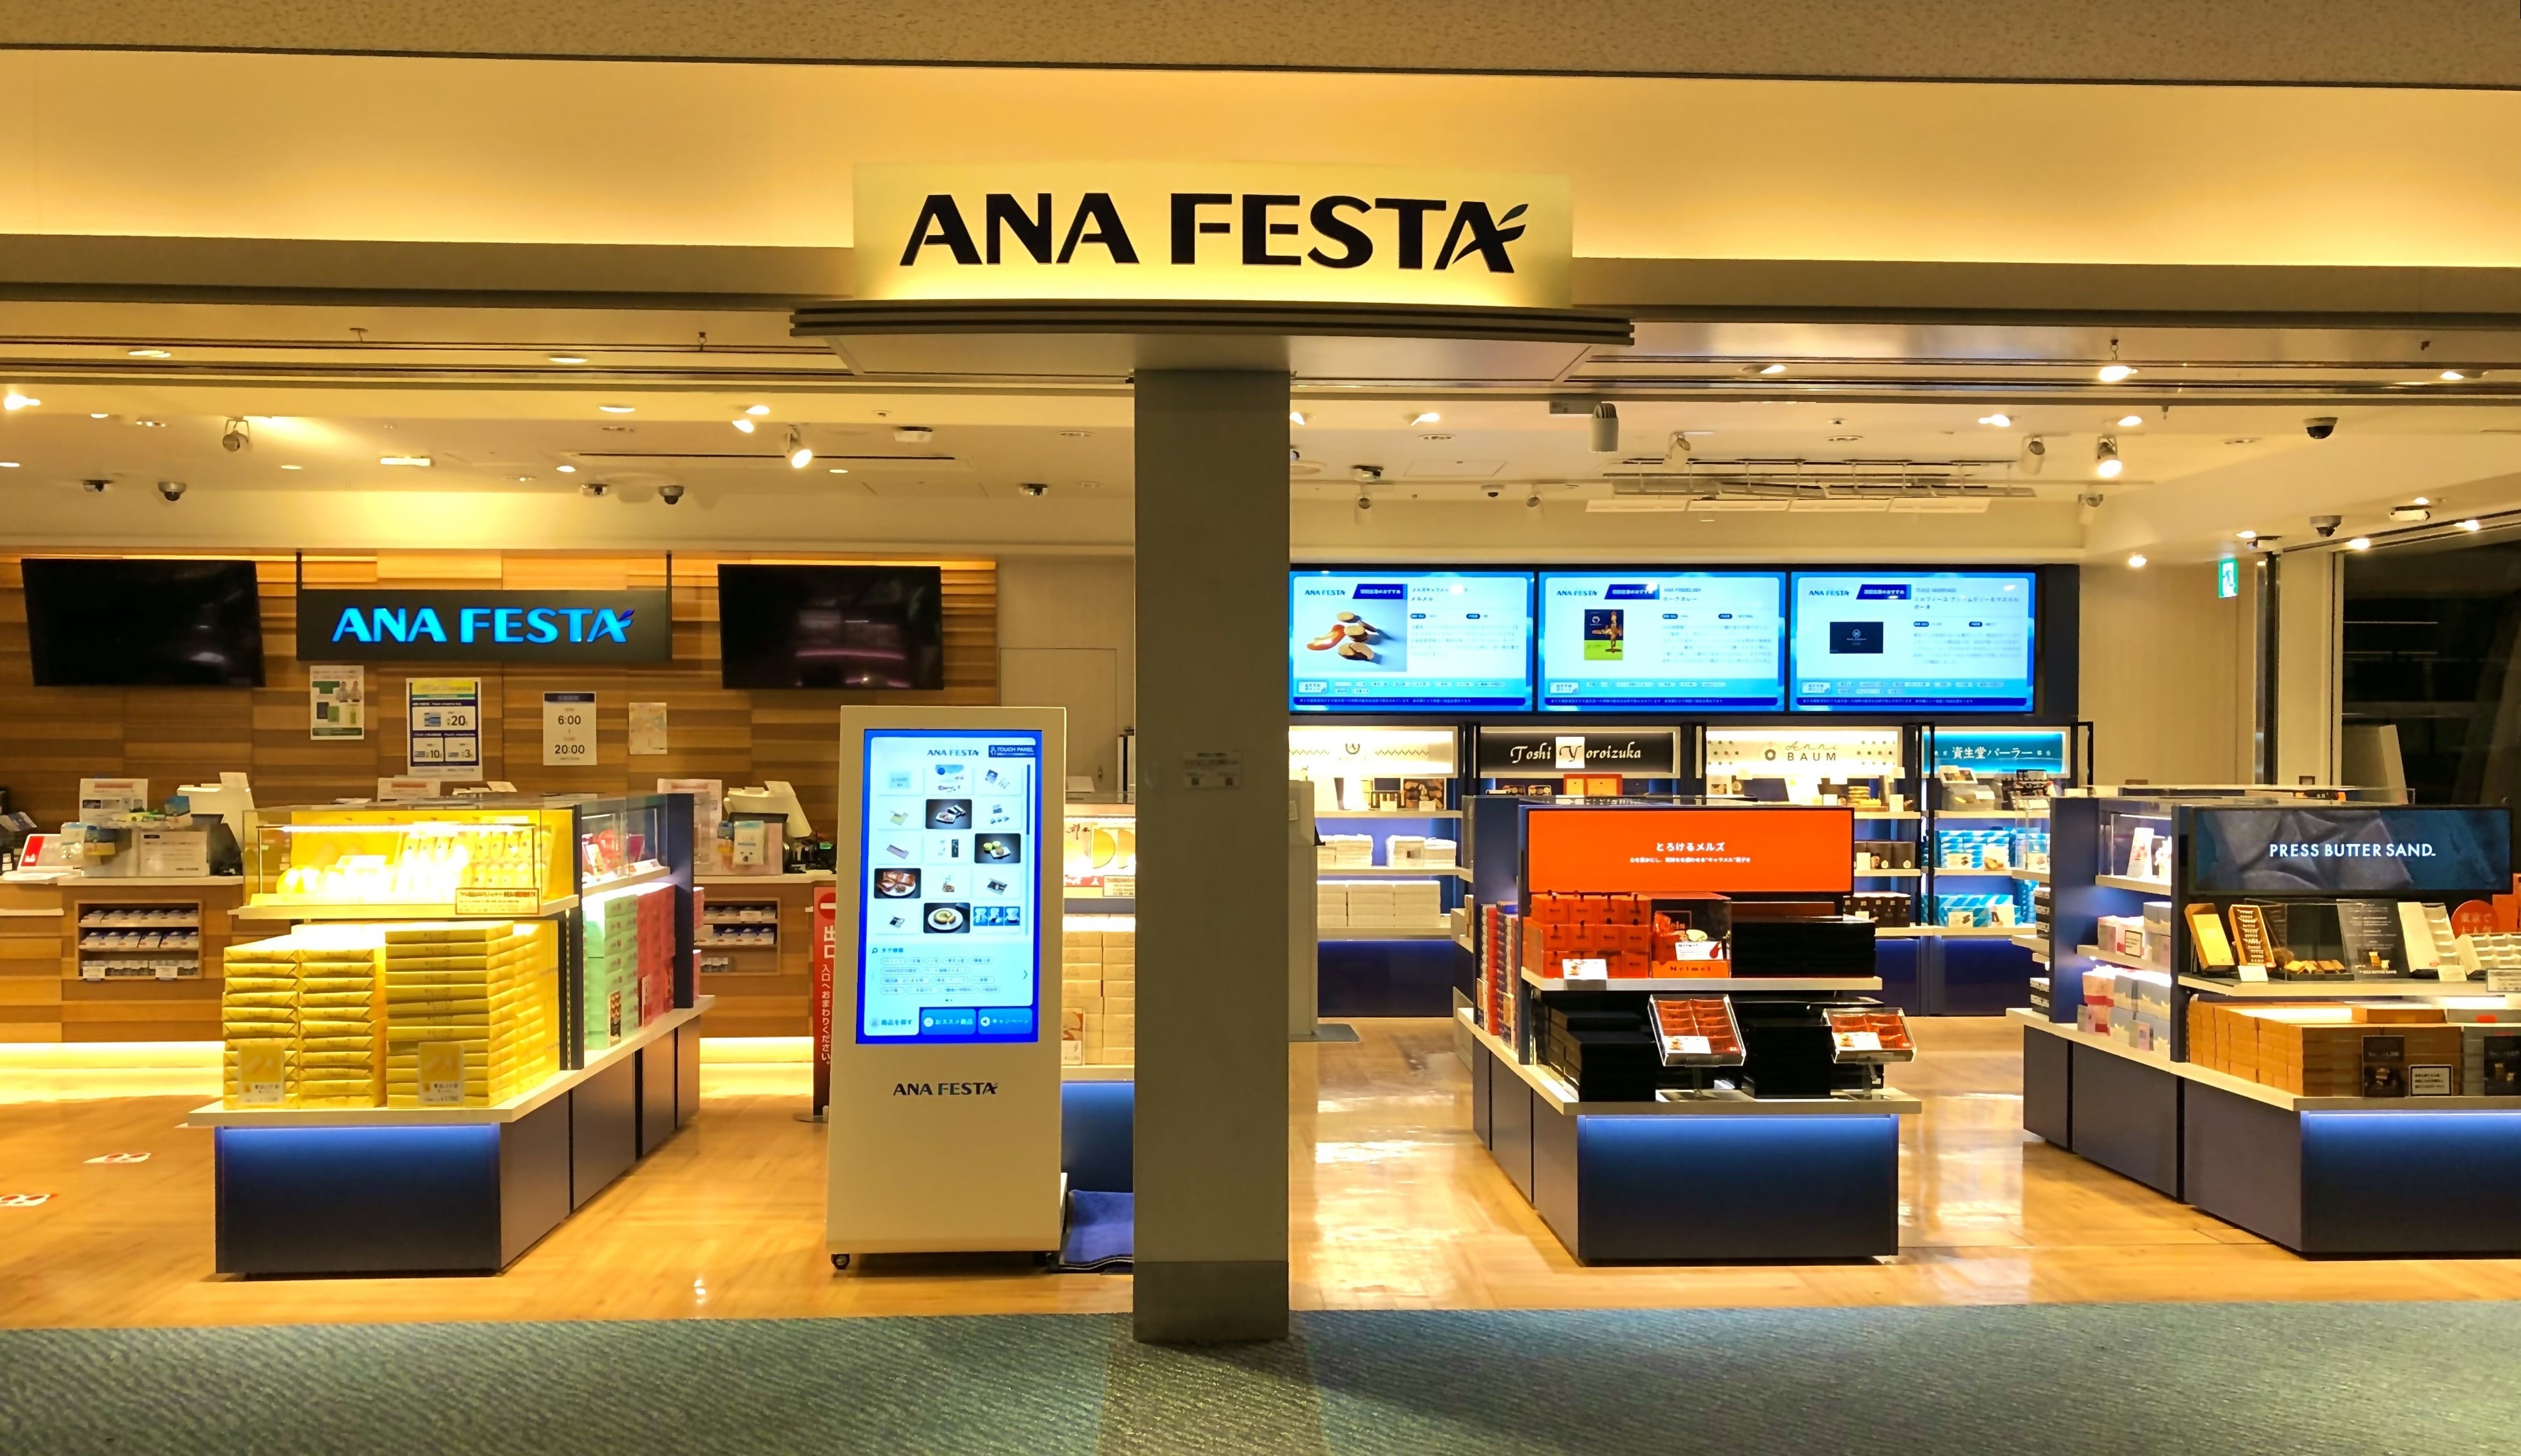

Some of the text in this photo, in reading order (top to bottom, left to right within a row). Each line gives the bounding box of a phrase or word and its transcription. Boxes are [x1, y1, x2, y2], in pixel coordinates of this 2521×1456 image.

[899, 192, 1529, 274] ANA FESTA
[332, 607, 635, 643] ANA FESTA
[558, 715, 581, 725] 6:00
[555, 744, 585, 755] 20:00
[1510, 742, 1551, 764] Toshi
[1787, 752, 1836, 761] BAUM
[1952, 746, 2033, 760] 資生堂パーラー
[1655, 841, 1725, 852] とろけるメルズ
[2269, 843, 2319, 858] PRESS
[2324, 843, 2382, 858] BUTTER
[2460, 912, 2493, 923] 東京で
[893, 1082, 999, 1096] ANA FESTA
